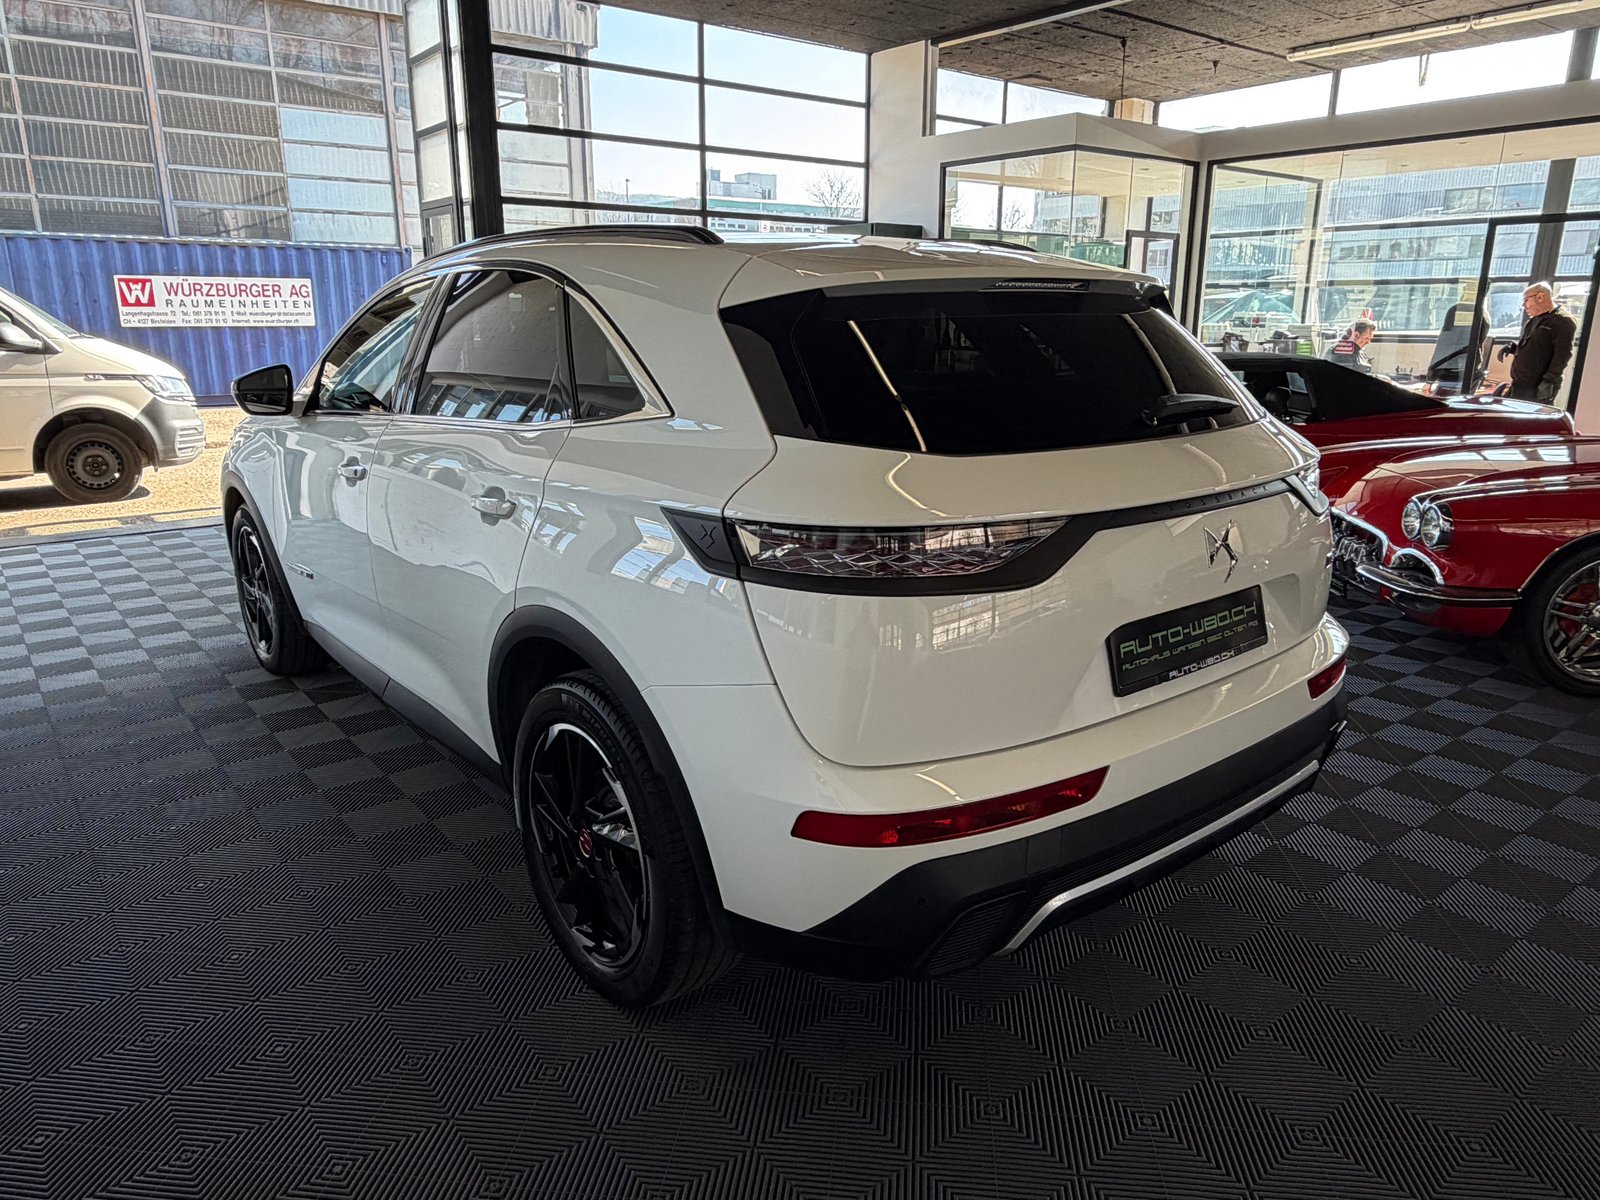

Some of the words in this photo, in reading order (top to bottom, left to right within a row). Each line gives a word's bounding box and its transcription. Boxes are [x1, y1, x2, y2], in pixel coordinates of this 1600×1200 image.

[163, 278, 282, 298] WÜRZBURGER
[289, 283, 310, 299] AG
[121, 310, 169, 318] Langenhagstrasse
[165, 298, 312, 309] RAUMEINHEITEN
[1152, 484, 1269, 515] ROSSBACK
[1122, 649, 1171, 672] AUTOHAUS
[1172, 639, 1206, 655] WANGEN
